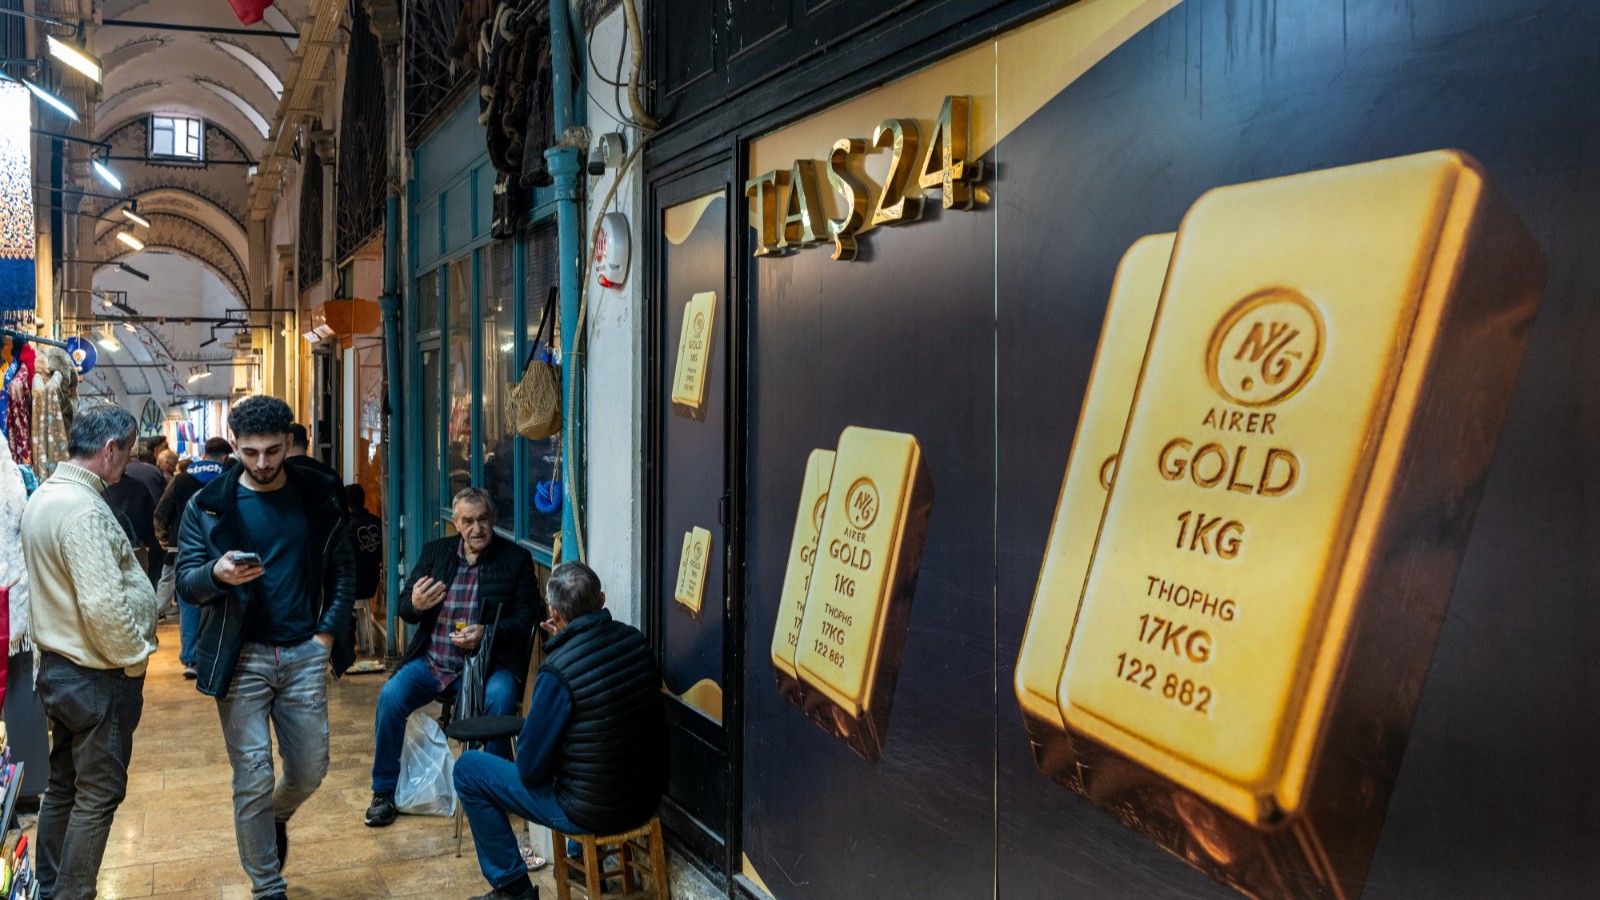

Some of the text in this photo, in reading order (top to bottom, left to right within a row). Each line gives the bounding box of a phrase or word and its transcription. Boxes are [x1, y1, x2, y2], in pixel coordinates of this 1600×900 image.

[745, 95, 980, 262] TAŞ24
[1202, 408, 1277, 435] AIRER
[1158, 437, 1301, 498] GOLD
[829, 538, 872, 571] GOLD
[1175, 510, 1245, 560] 1KG
[800, 545, 816, 567] GO
[834, 573, 856, 598] 1KG
[1147, 575, 1237, 622] THOPHG
[822, 621, 846, 646] 17KG
[1138, 613, 1213, 664] 17KG
[814, 639, 845, 669] 122 882
[1116, 652, 1213, 715] 122 882
